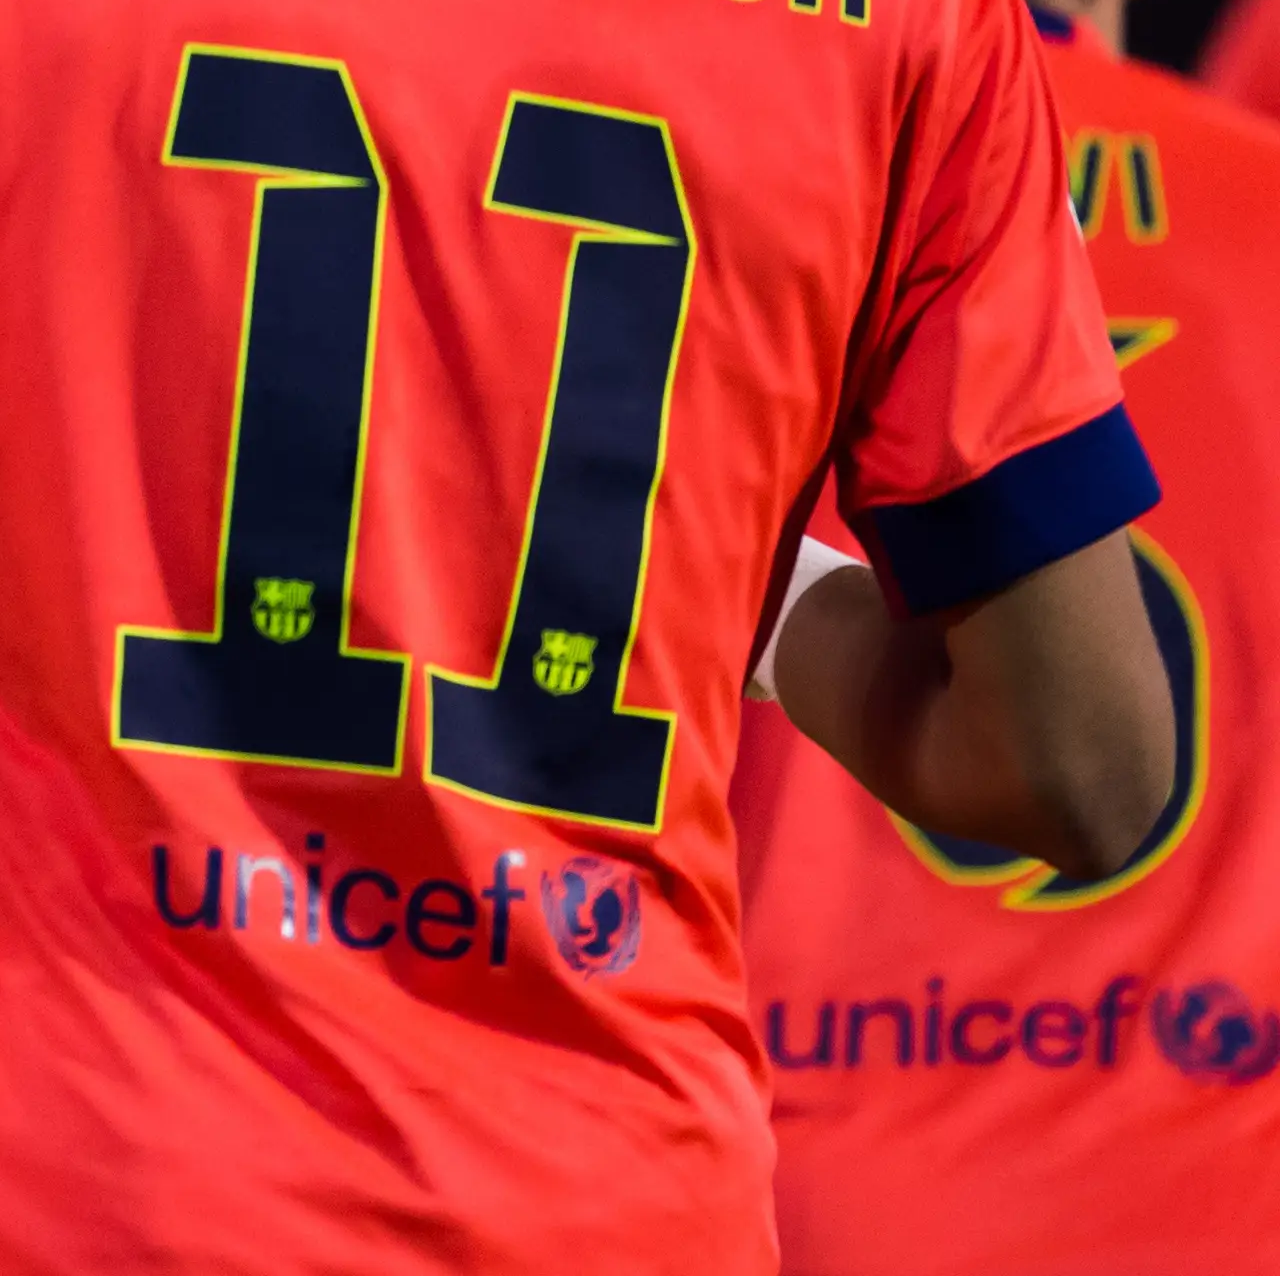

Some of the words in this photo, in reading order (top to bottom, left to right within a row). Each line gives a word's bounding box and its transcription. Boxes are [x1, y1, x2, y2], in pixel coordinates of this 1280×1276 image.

[111, 41, 696, 834] 11
[152, 832, 526, 967] unicef
[765, 976, 1140, 1069] unicef
